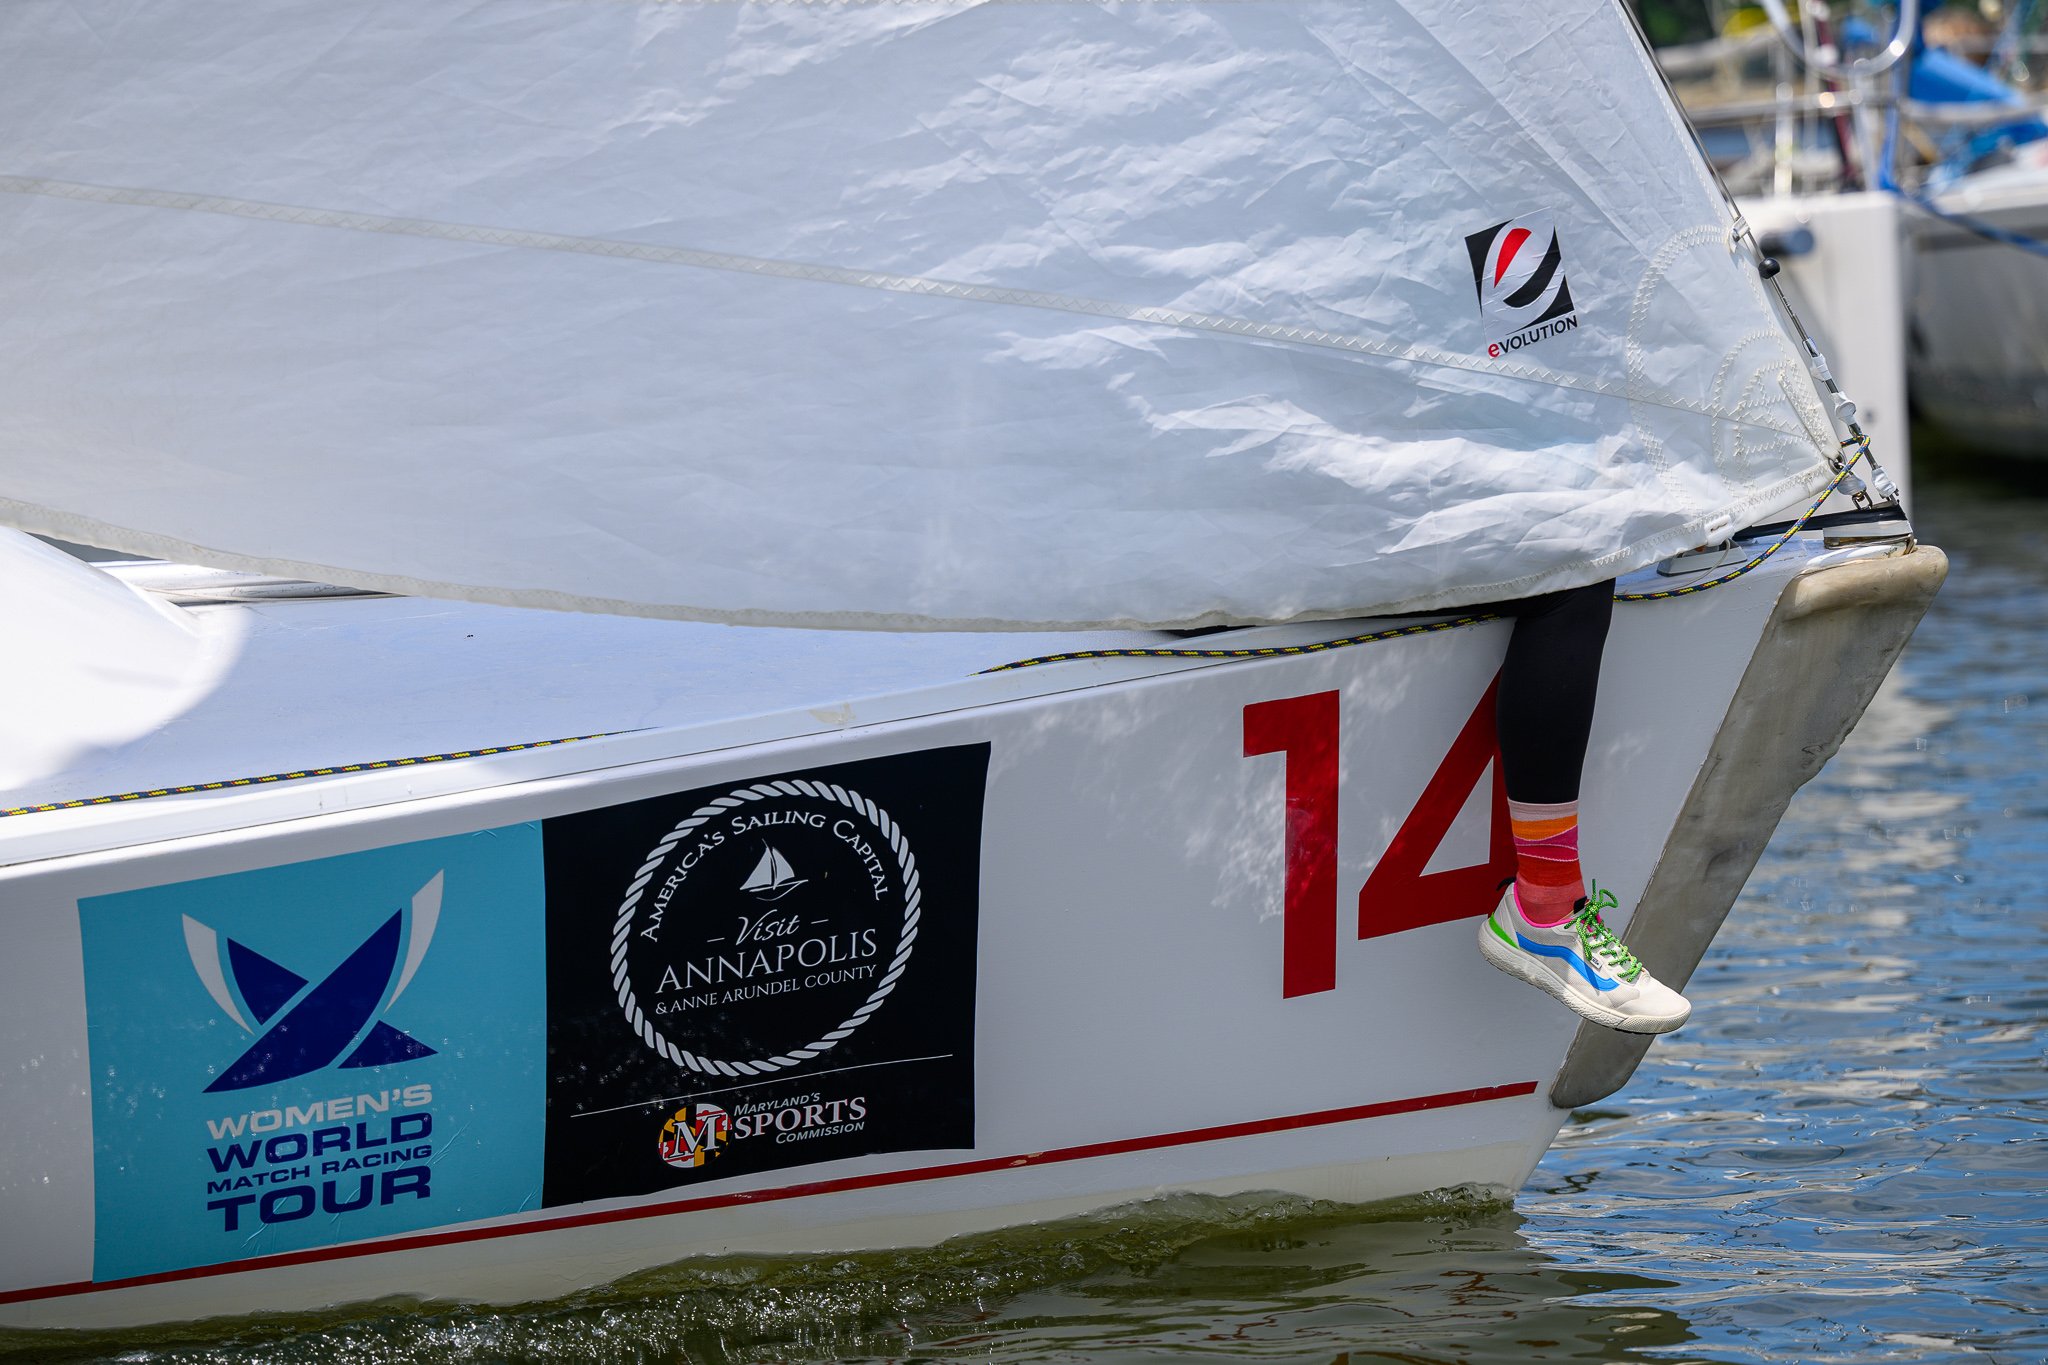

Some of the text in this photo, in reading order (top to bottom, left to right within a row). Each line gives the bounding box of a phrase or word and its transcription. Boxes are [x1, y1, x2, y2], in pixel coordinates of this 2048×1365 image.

[1488, 315, 1578, 358] eVOLUTION
[731, 810, 826, 835] SAILING
[833, 819, 888, 900] CAPITAL
[1243, 662, 1519, 999] 14
[735, 909, 800, 945] Visit
[655, 928, 877, 994] ANNAPOLIS
[655, 964, 877, 1015] & ANNE ARUNDEL COUNTY
[206, 1083, 433, 1140] WOMEN'S
[669, 1114, 723, 1158] M
[734, 1097, 867, 1140] SPORTS
[775, 1121, 865, 1144] COMMISSION
[206, 1112, 433, 1174] WORLD
[207, 1144, 432, 1195] MATCH RACING
[207, 1165, 431, 1232] TOUR
